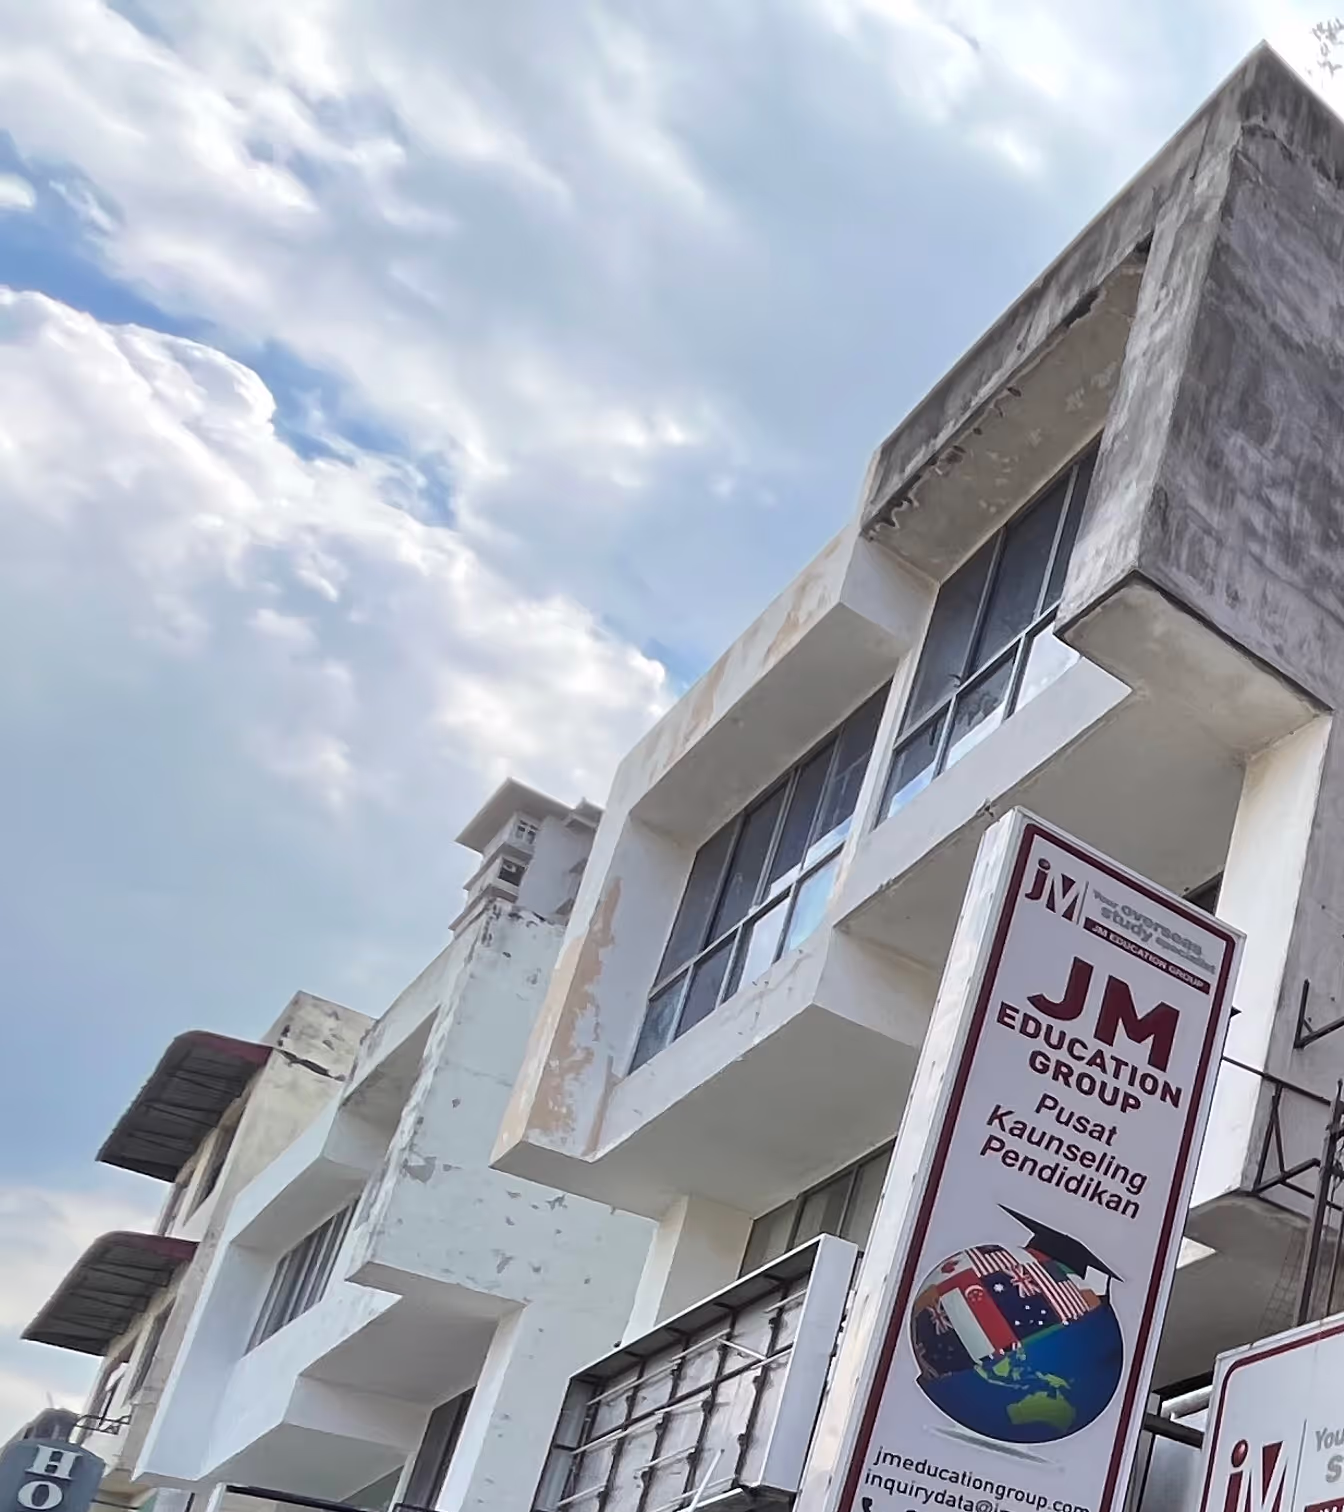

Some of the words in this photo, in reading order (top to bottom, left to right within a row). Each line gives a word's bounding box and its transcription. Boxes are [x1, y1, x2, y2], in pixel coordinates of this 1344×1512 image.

[1100, 905, 1153, 943] study
[1120, 903, 1203, 956] overseas
[1108, 932, 1168, 970] EDUCATION
[1167, 962, 1205, 989] GROUP
[1027, 956, 1181, 1074] JM
[996, 1001, 1183, 1109] EDUCATION
[1028, 1049, 1143, 1114] GROUP
[985, 1104, 1149, 1196] Kaunseling
[1034, 1093, 1119, 1148] Pusat
[979, 1134, 1141, 1220] Pendidikan
